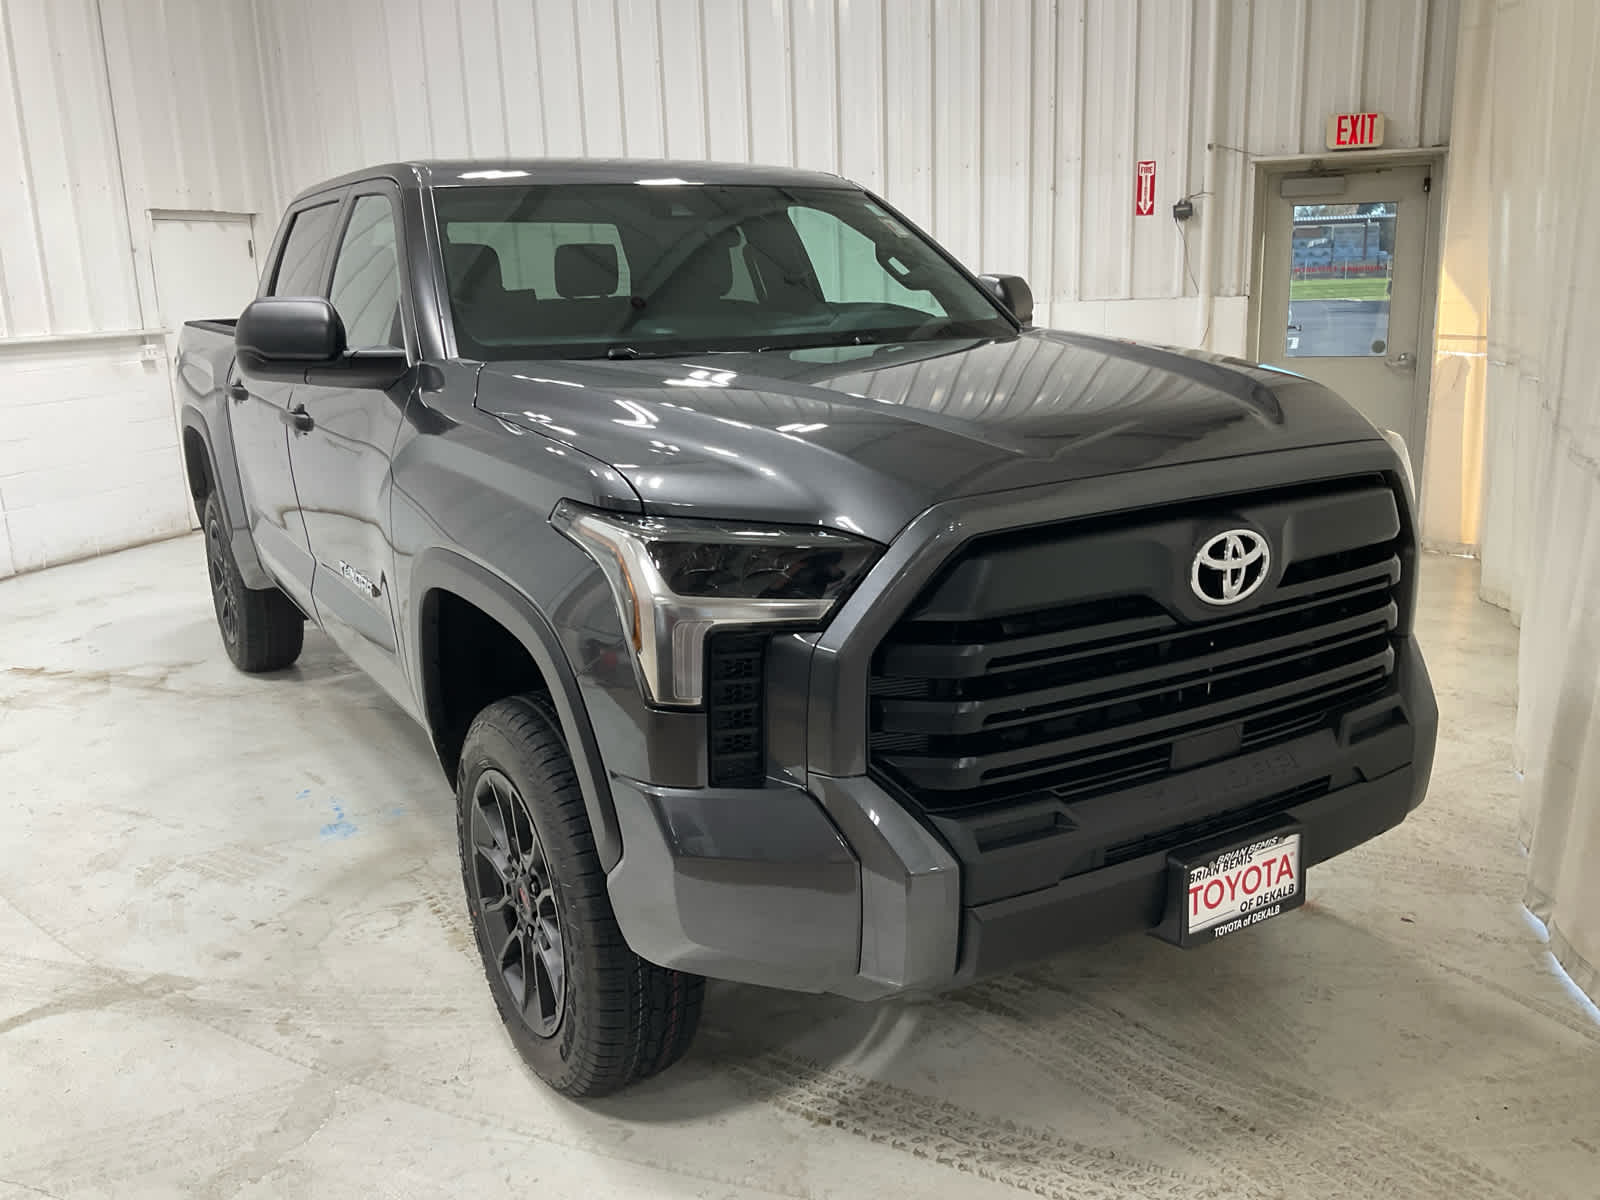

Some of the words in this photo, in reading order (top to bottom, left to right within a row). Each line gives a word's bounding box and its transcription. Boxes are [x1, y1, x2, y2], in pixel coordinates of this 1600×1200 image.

[1336, 113, 1378, 145] EXIT
[1216, 847, 1249, 865] BRIAN
[1248, 836, 1279, 854] BEMIS
[1190, 865, 1220, 883] BRIAN
[1222, 854, 1253, 873] BEMIS
[1188, 853, 1294, 916] TOYOTA
[1239, 898, 1255, 913] OF
[1255, 883, 1295, 907] DEKALB
[1214, 919, 1242, 937] TOYOTA
[1243, 915, 1252, 927] of
[1252, 904, 1280, 923] DEKALB
